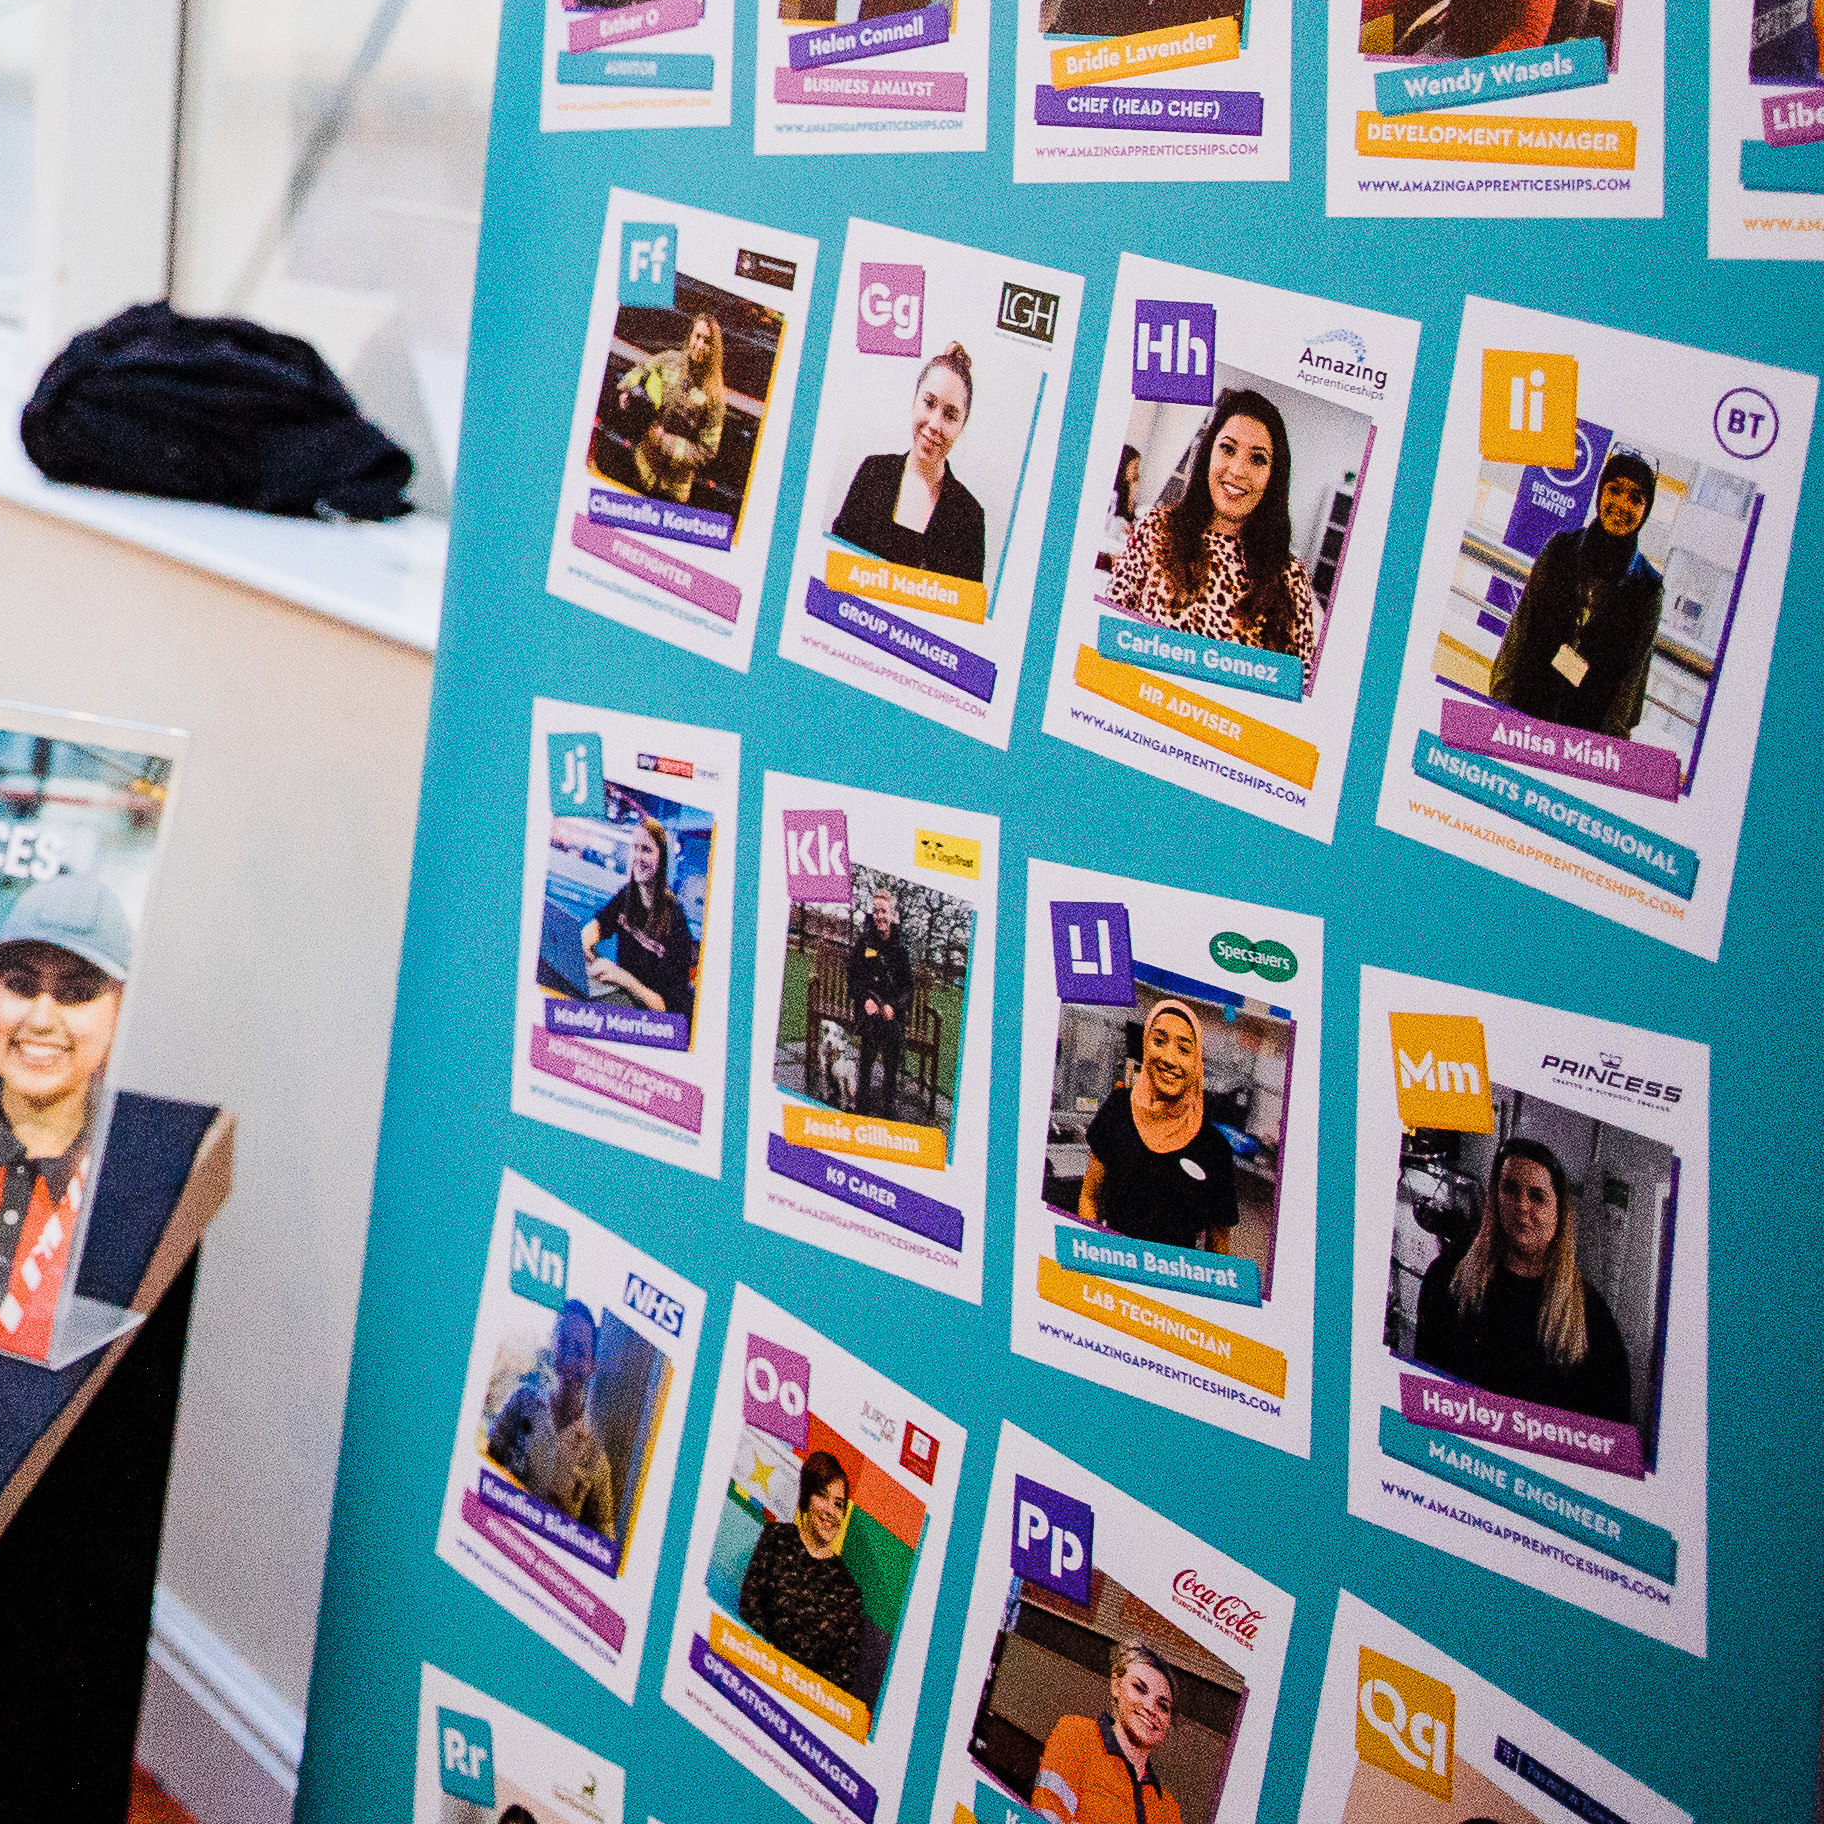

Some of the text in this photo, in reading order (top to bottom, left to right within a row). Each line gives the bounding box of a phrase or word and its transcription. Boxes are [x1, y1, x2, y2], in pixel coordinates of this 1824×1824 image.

[808, 14, 925, 57] Helen Connell
[1064, 32, 1218, 75] Bridie Lavender
[802, 77, 935, 97] BUSINESS ANALYST
[1403, 51, 1574, 102] Wendy Wasels
[1066, 96, 1222, 120] CHEF (HEAD CHEF)
[1034, 142, 1259, 160] WWW.AMAZINGAPPRENTICESHIPS.COM
[1366, 123, 1620, 153] DEVELOPMENT MANAGER
[1357, 177, 1632, 193] WWW.AMAZINGAPPRENTICESHIPS.COM
[628, 234, 670, 285] Ff
[859, 281, 921, 341] Gg
[1001, 286, 1057, 336] LGH
[1136, 318, 1209, 376] Hh
[1298, 346, 1388, 390] Amazing
[1297, 368, 1385, 402] Apprenticeships
[1725, 408, 1766, 441] BT
[1531, 481, 1576, 509] BEYOND
[1531, 494, 1568, 519] LIMITS
[846, 563, 960, 606] April Madden
[837, 600, 959, 674] GROUP MANAGER
[1115, 629, 1280, 684] Carleen Gomez
[1138, 682, 1242, 742] HR ADVISER
[1069, 705, 1308, 809] WWW.AMAZINGAPPRENTICESHIPS.COM
[1490, 720, 1622, 773] Anisa Miah
[561, 743, 589, 805] Jj
[1426, 745, 1681, 877] INSIGHTS PROFESSIONAL
[786, 823, 848, 877] Kk
[1408, 797, 1686, 921] WWW.AMAZINGAPPRENTICESHIPS.COM
[1216, 939, 1290, 971] Specsavers
[1398, 1050, 1482, 1096] Mm
[1540, 1054, 1684, 1104] PRINCESS
[854, 1124, 921, 1154] Gillham
[826, 1166, 898, 1210] K9 CARER
[513, 1227, 564, 1289] Nn
[1071, 1237, 1238, 1288] Henna Basharat
[627, 1279, 684, 1334] NHS
[1080, 1283, 1233, 1361] LAB TECHNICIAN
[746, 1357, 807, 1417] Oo
[1037, 1320, 1282, 1417] WWW.AMAZINGAPPRENTICESHIPS.COM
[1421, 1388, 1615, 1457] Hayley Spencer
[1428, 1439, 1623, 1542] MARINE ENGINEER
[1016, 1498, 1085, 1579] Pp
[1380, 1479, 1671, 1606] WWW.AMAZINGAPPRENTICESHIPS.COM
[703, 1653, 860, 1800] OPERATIONS MANAGER
